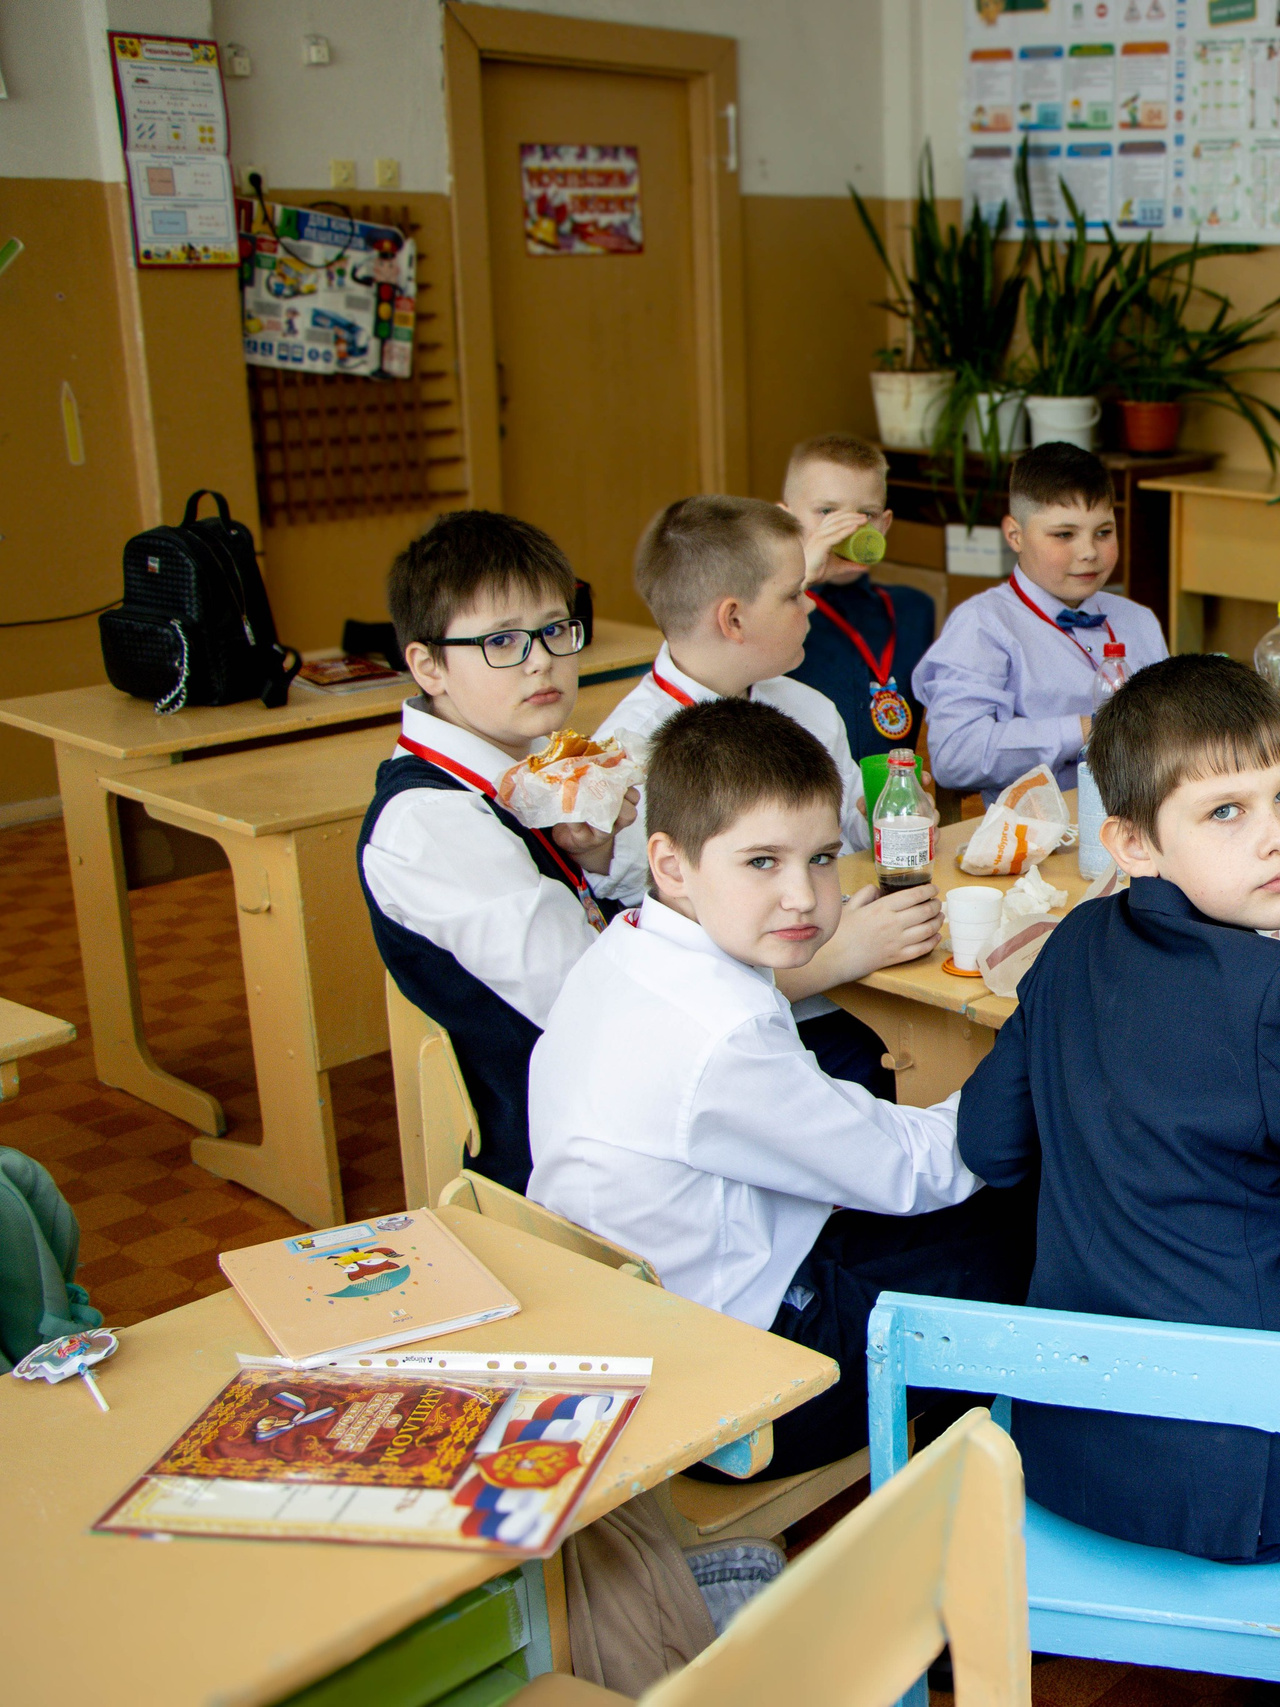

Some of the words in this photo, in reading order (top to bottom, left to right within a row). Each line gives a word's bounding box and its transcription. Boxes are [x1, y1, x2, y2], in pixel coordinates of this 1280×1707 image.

[1146, 109, 1162, 121] 04
[1141, 207, 1163, 222] 112
[993, 821, 1010, 866] Чизбургер
[326, 1402, 367, 1439] ШКОЛЫ
[334, 1392, 390, 1451] НАЧАЛЬНОЙ
[350, 1392, 404, 1453] ОКОНЧАНИИ
[378, 1388, 445, 1464] ДИПЛОМ
[383, 1413, 403, 1428] ОБ
